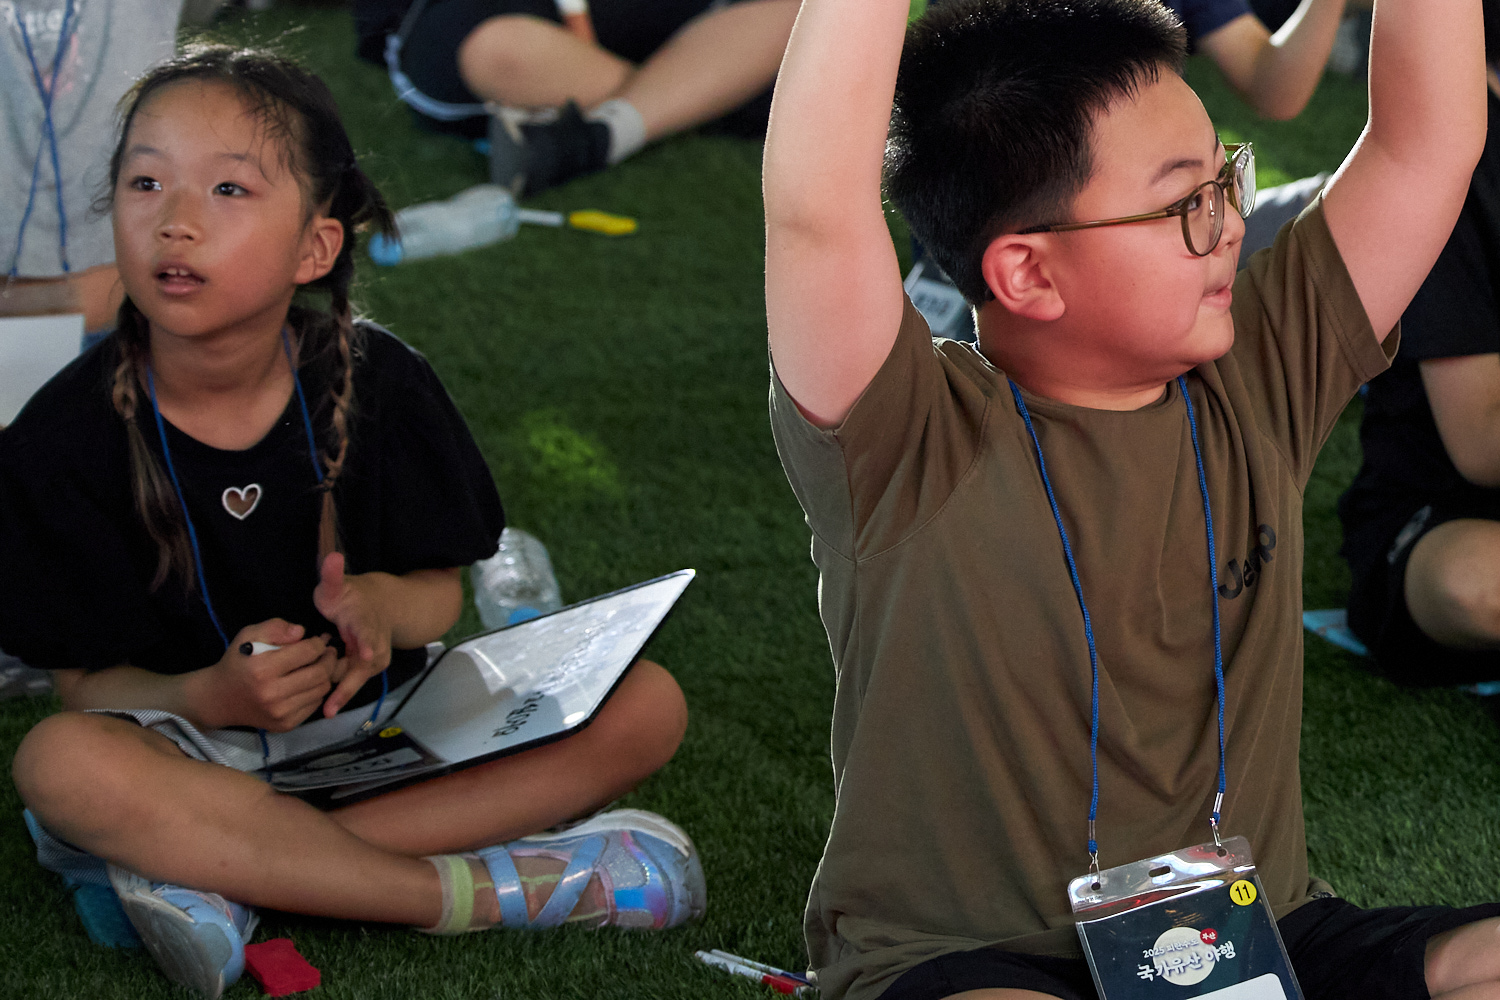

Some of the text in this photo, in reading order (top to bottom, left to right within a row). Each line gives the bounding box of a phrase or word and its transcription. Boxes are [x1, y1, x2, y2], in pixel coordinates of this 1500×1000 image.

[1235, 883, 1251, 901] 11
[1136, 940, 1236, 982] 국가유산 야행
[1142, 946, 1165, 959] 2025
